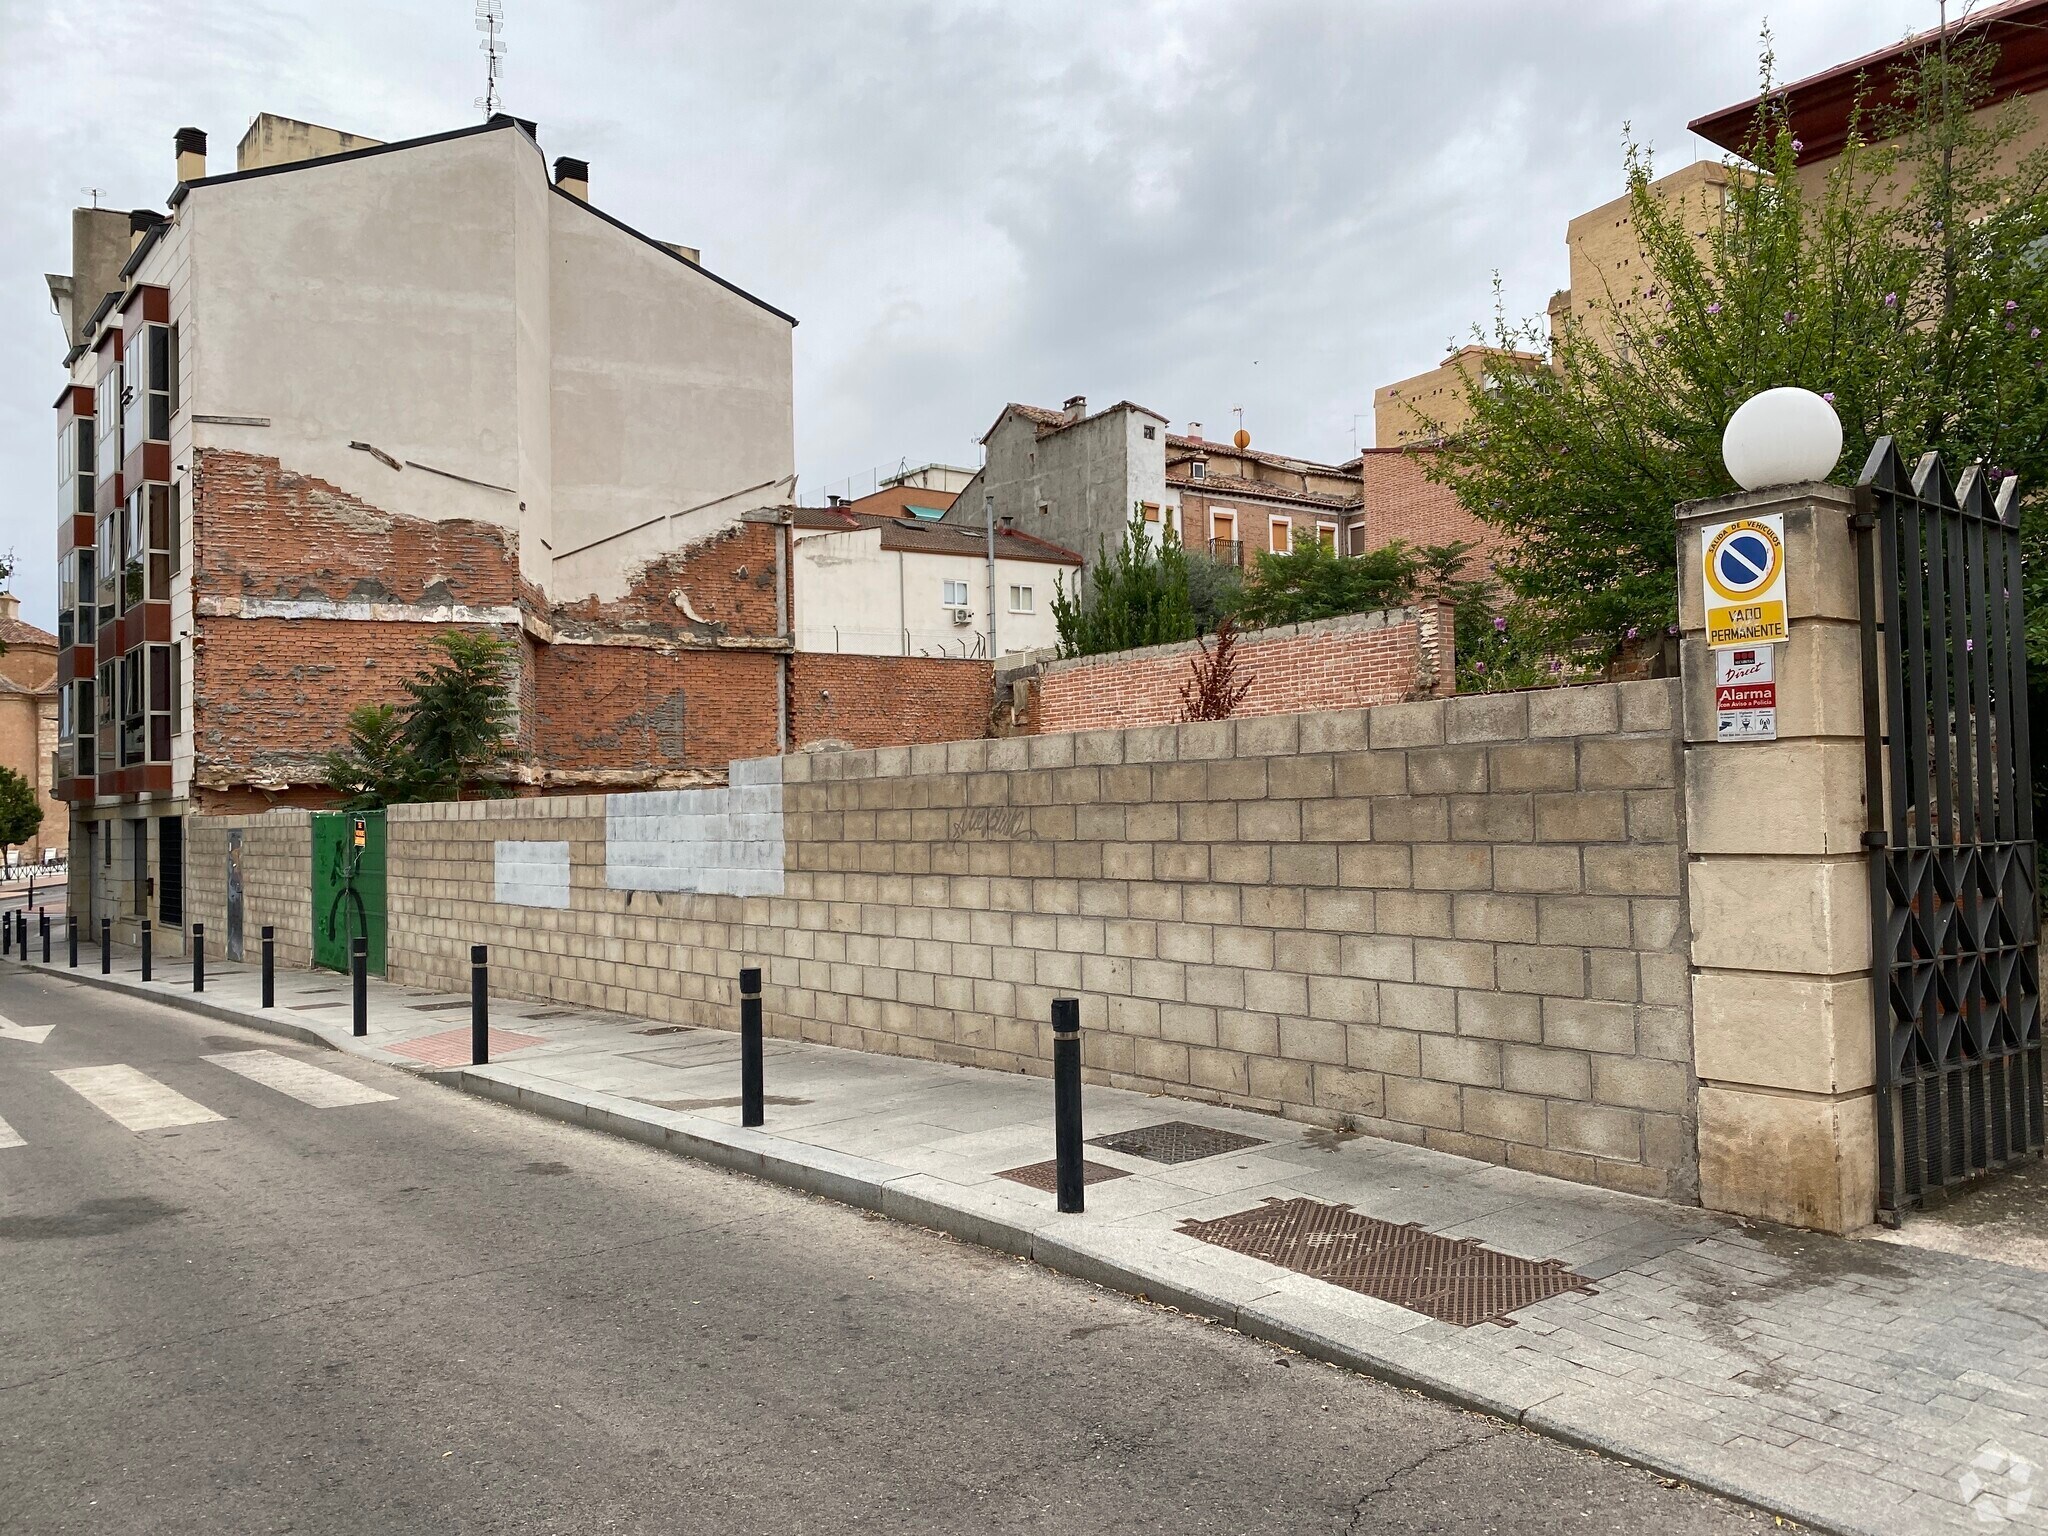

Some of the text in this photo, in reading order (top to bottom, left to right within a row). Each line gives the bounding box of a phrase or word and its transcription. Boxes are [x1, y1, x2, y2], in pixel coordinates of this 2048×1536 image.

[1708, 521, 1781, 553] SALIDA DE VEHICULOS
[1728, 607, 1762, 622] VADO
[1711, 623, 1782, 642] PERMANENTE
[1725, 662, 1766, 682] Direct
[1720, 689, 1772, 700] Alarma
